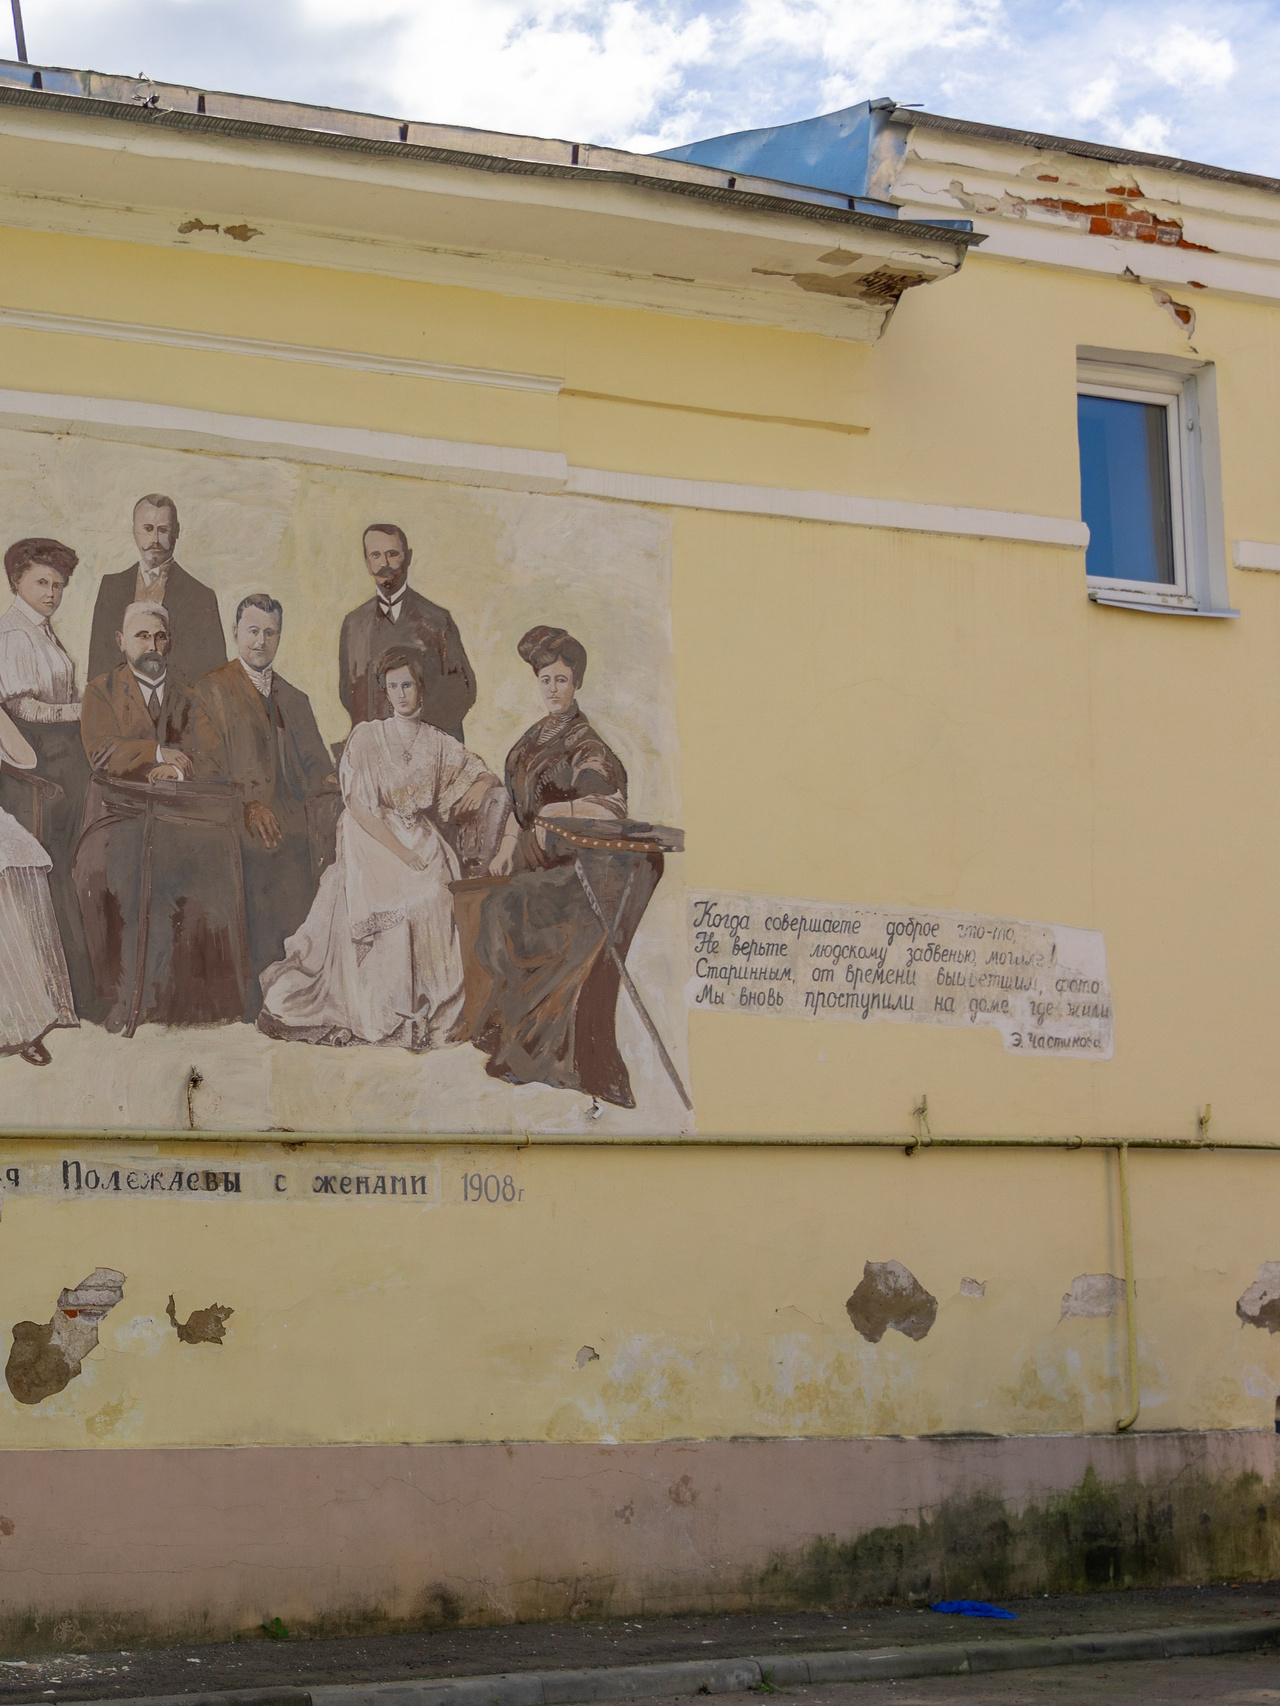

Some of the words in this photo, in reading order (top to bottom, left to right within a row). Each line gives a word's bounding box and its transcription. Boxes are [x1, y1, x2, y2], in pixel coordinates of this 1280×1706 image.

[693, 901, 750, 938] Когда
[764, 913, 862, 940] совершаете
[886, 917, 940, 946] доброе
[694, 931, 720, 954] Не
[732, 935, 789, 962] верьте
[809, 944, 888, 968] людскому
[695, 957, 796, 985] Старинным,
[811, 966, 835, 982] от
[845, 964, 916, 991] времени
[695, 984, 725, 1006] Мы
[739, 986, 784, 1006] вновь
[804, 990, 915, 1020] проступили
[934, 995, 955, 1013] на
[969, 998, 1009, 1023] доме
[1029, 1000, 1054, 1026] где
[1066, 1002, 1110, 1019] жили
[1011, 1031, 1024, 1049] Э.
[274, 1173, 287, 1193] с
[312, 1174, 428, 1196] женами
